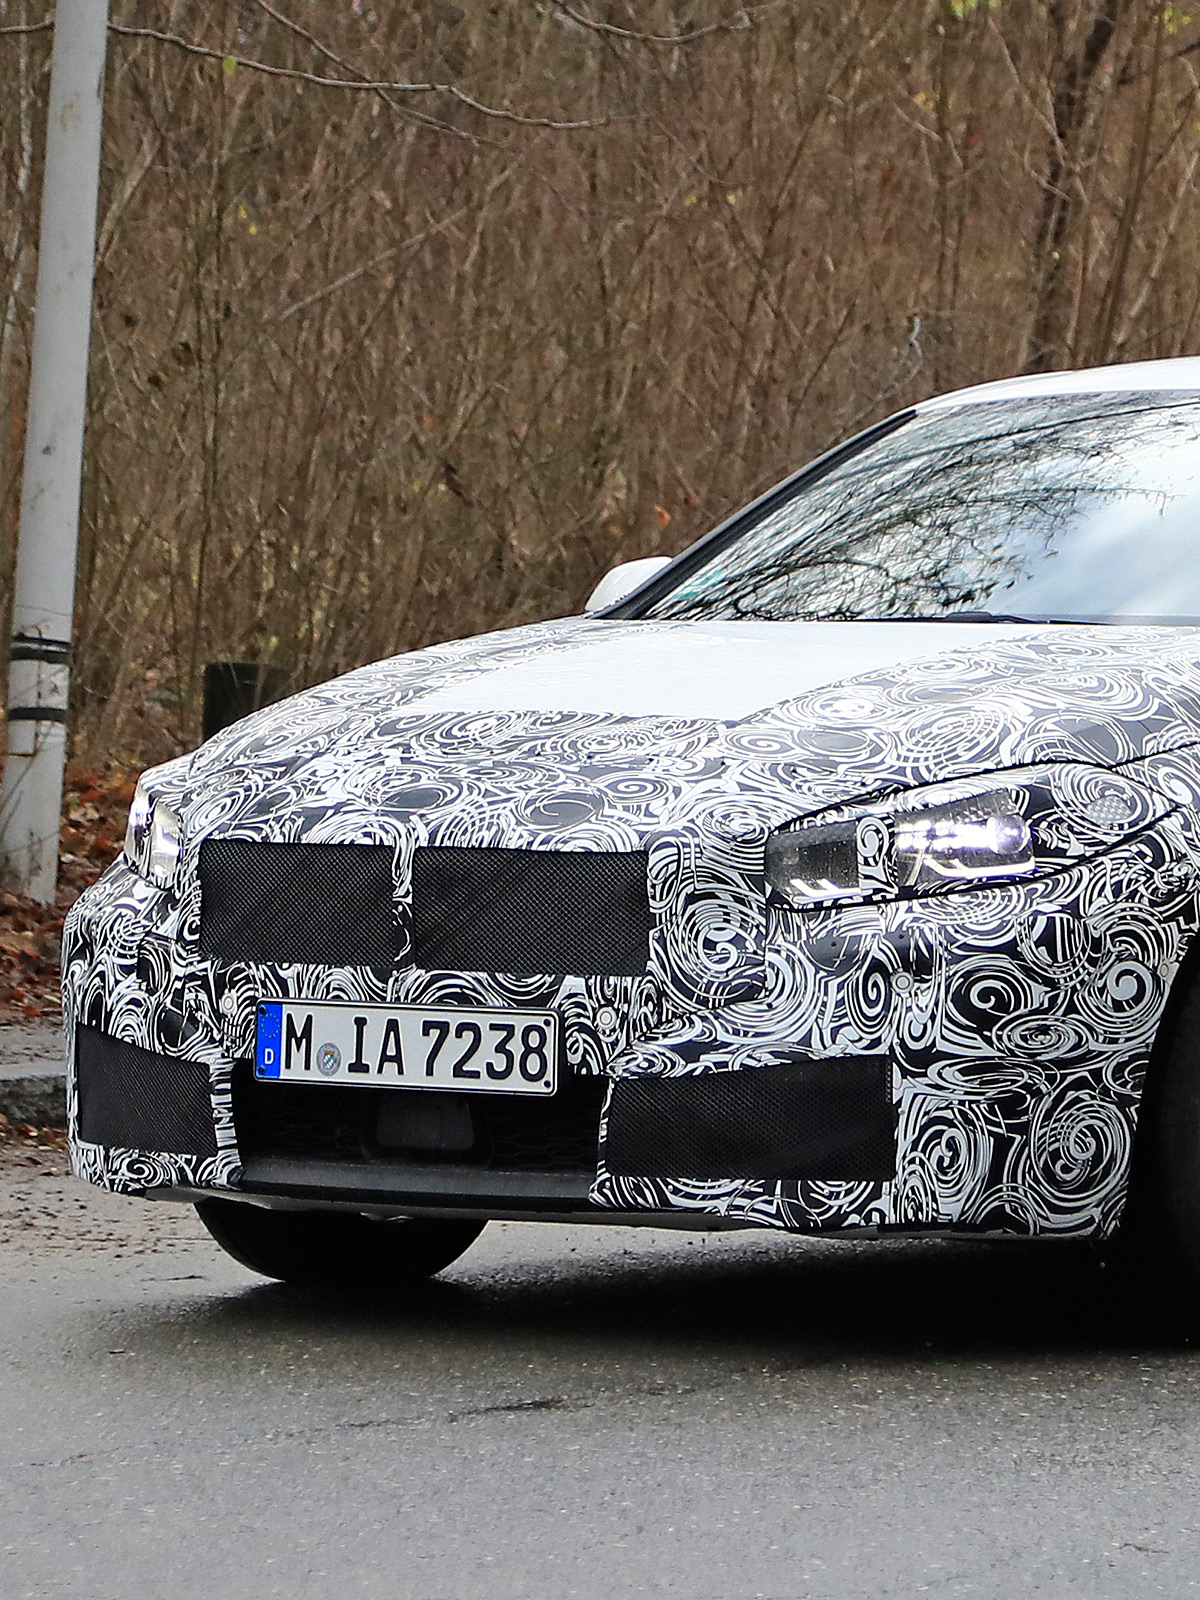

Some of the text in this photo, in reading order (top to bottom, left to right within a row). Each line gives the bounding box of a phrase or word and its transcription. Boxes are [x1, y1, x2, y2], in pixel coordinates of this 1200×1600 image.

[264, 1048, 274, 1064] D
[285, 1012, 548, 1083] M IA 7238
